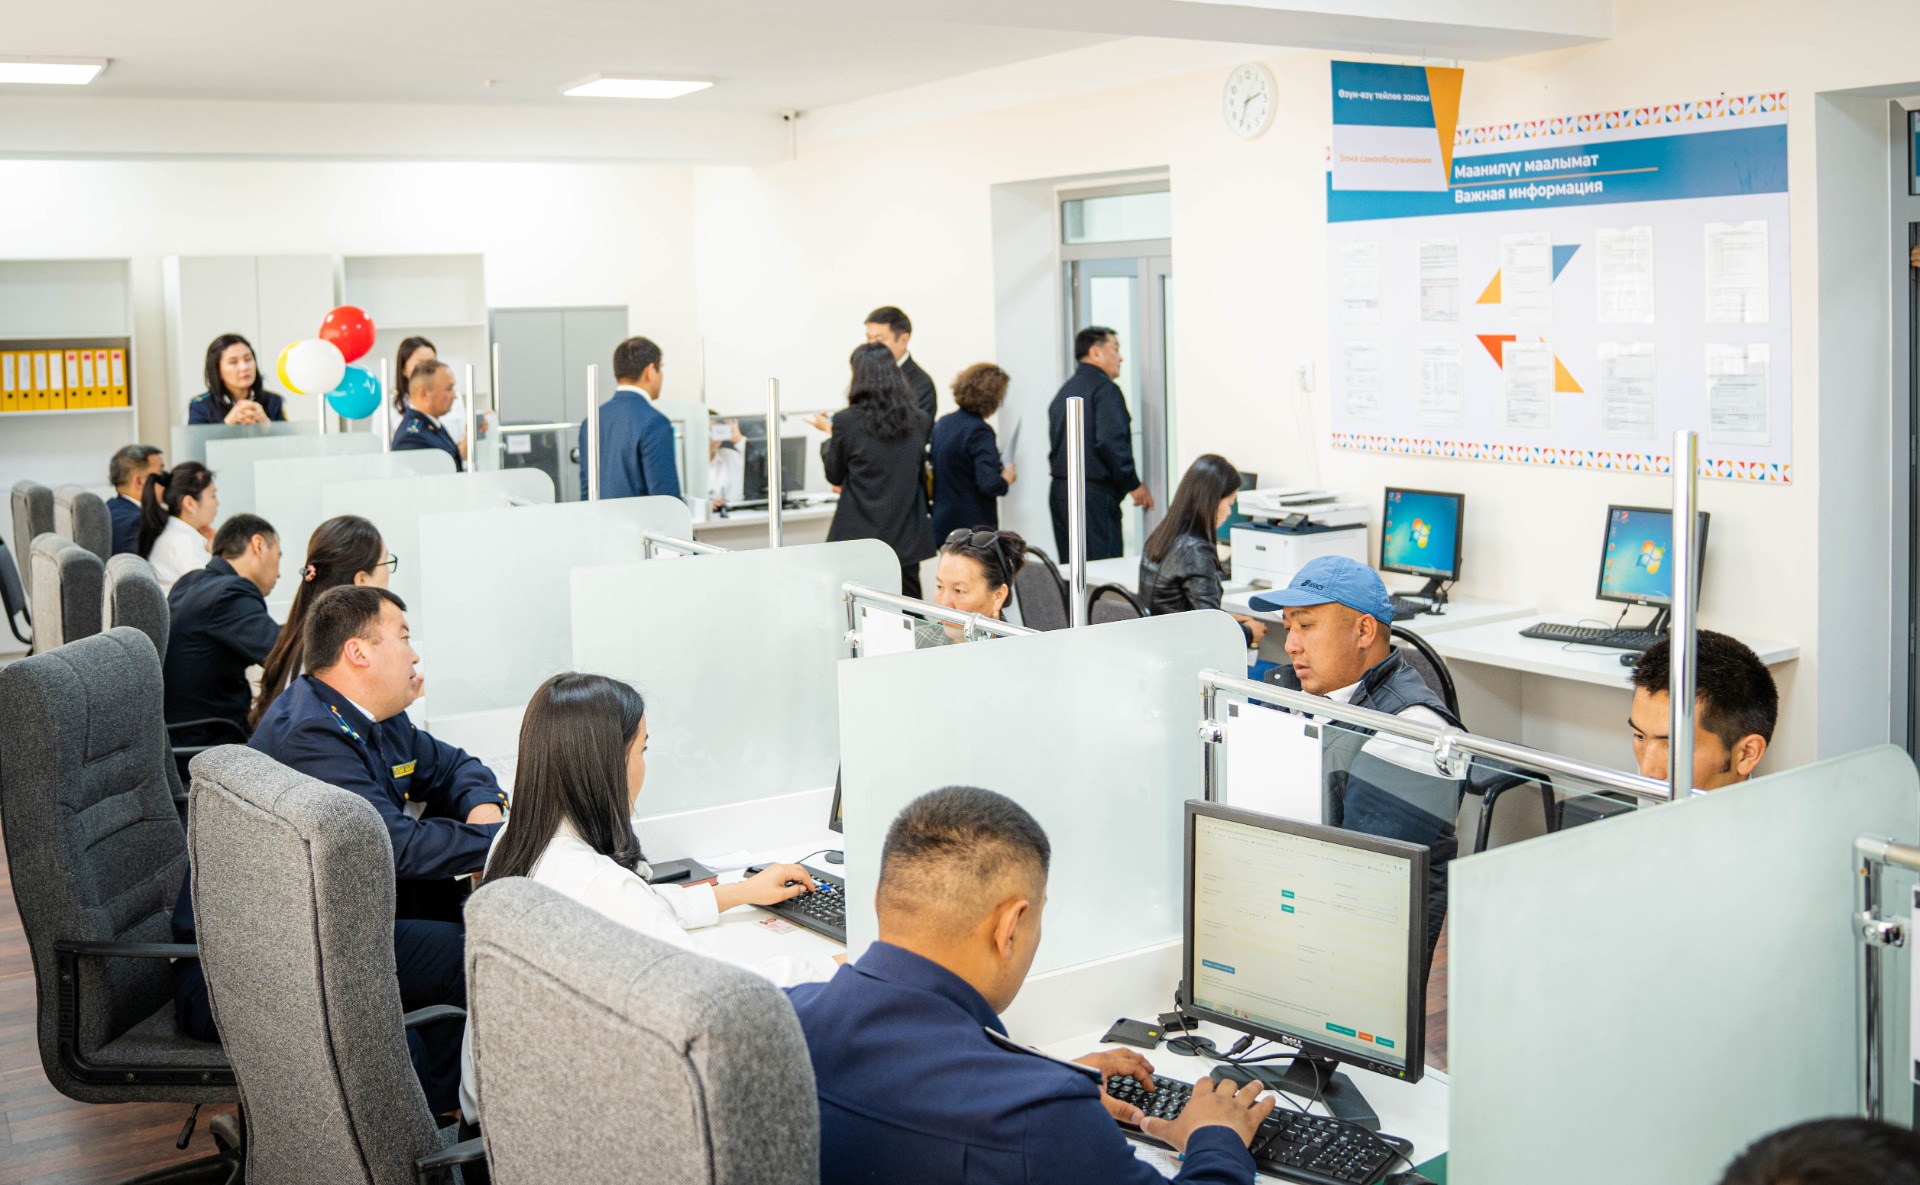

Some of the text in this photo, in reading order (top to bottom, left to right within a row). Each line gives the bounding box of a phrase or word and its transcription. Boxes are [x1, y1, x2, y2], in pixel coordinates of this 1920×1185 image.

[1403, 93, 1430, 103] зонасы
[1340, 153, 1358, 163] Зона
[1454, 154, 1599, 179] Маанилүү маалымат
[1454, 180, 1604, 204] Важная информация
